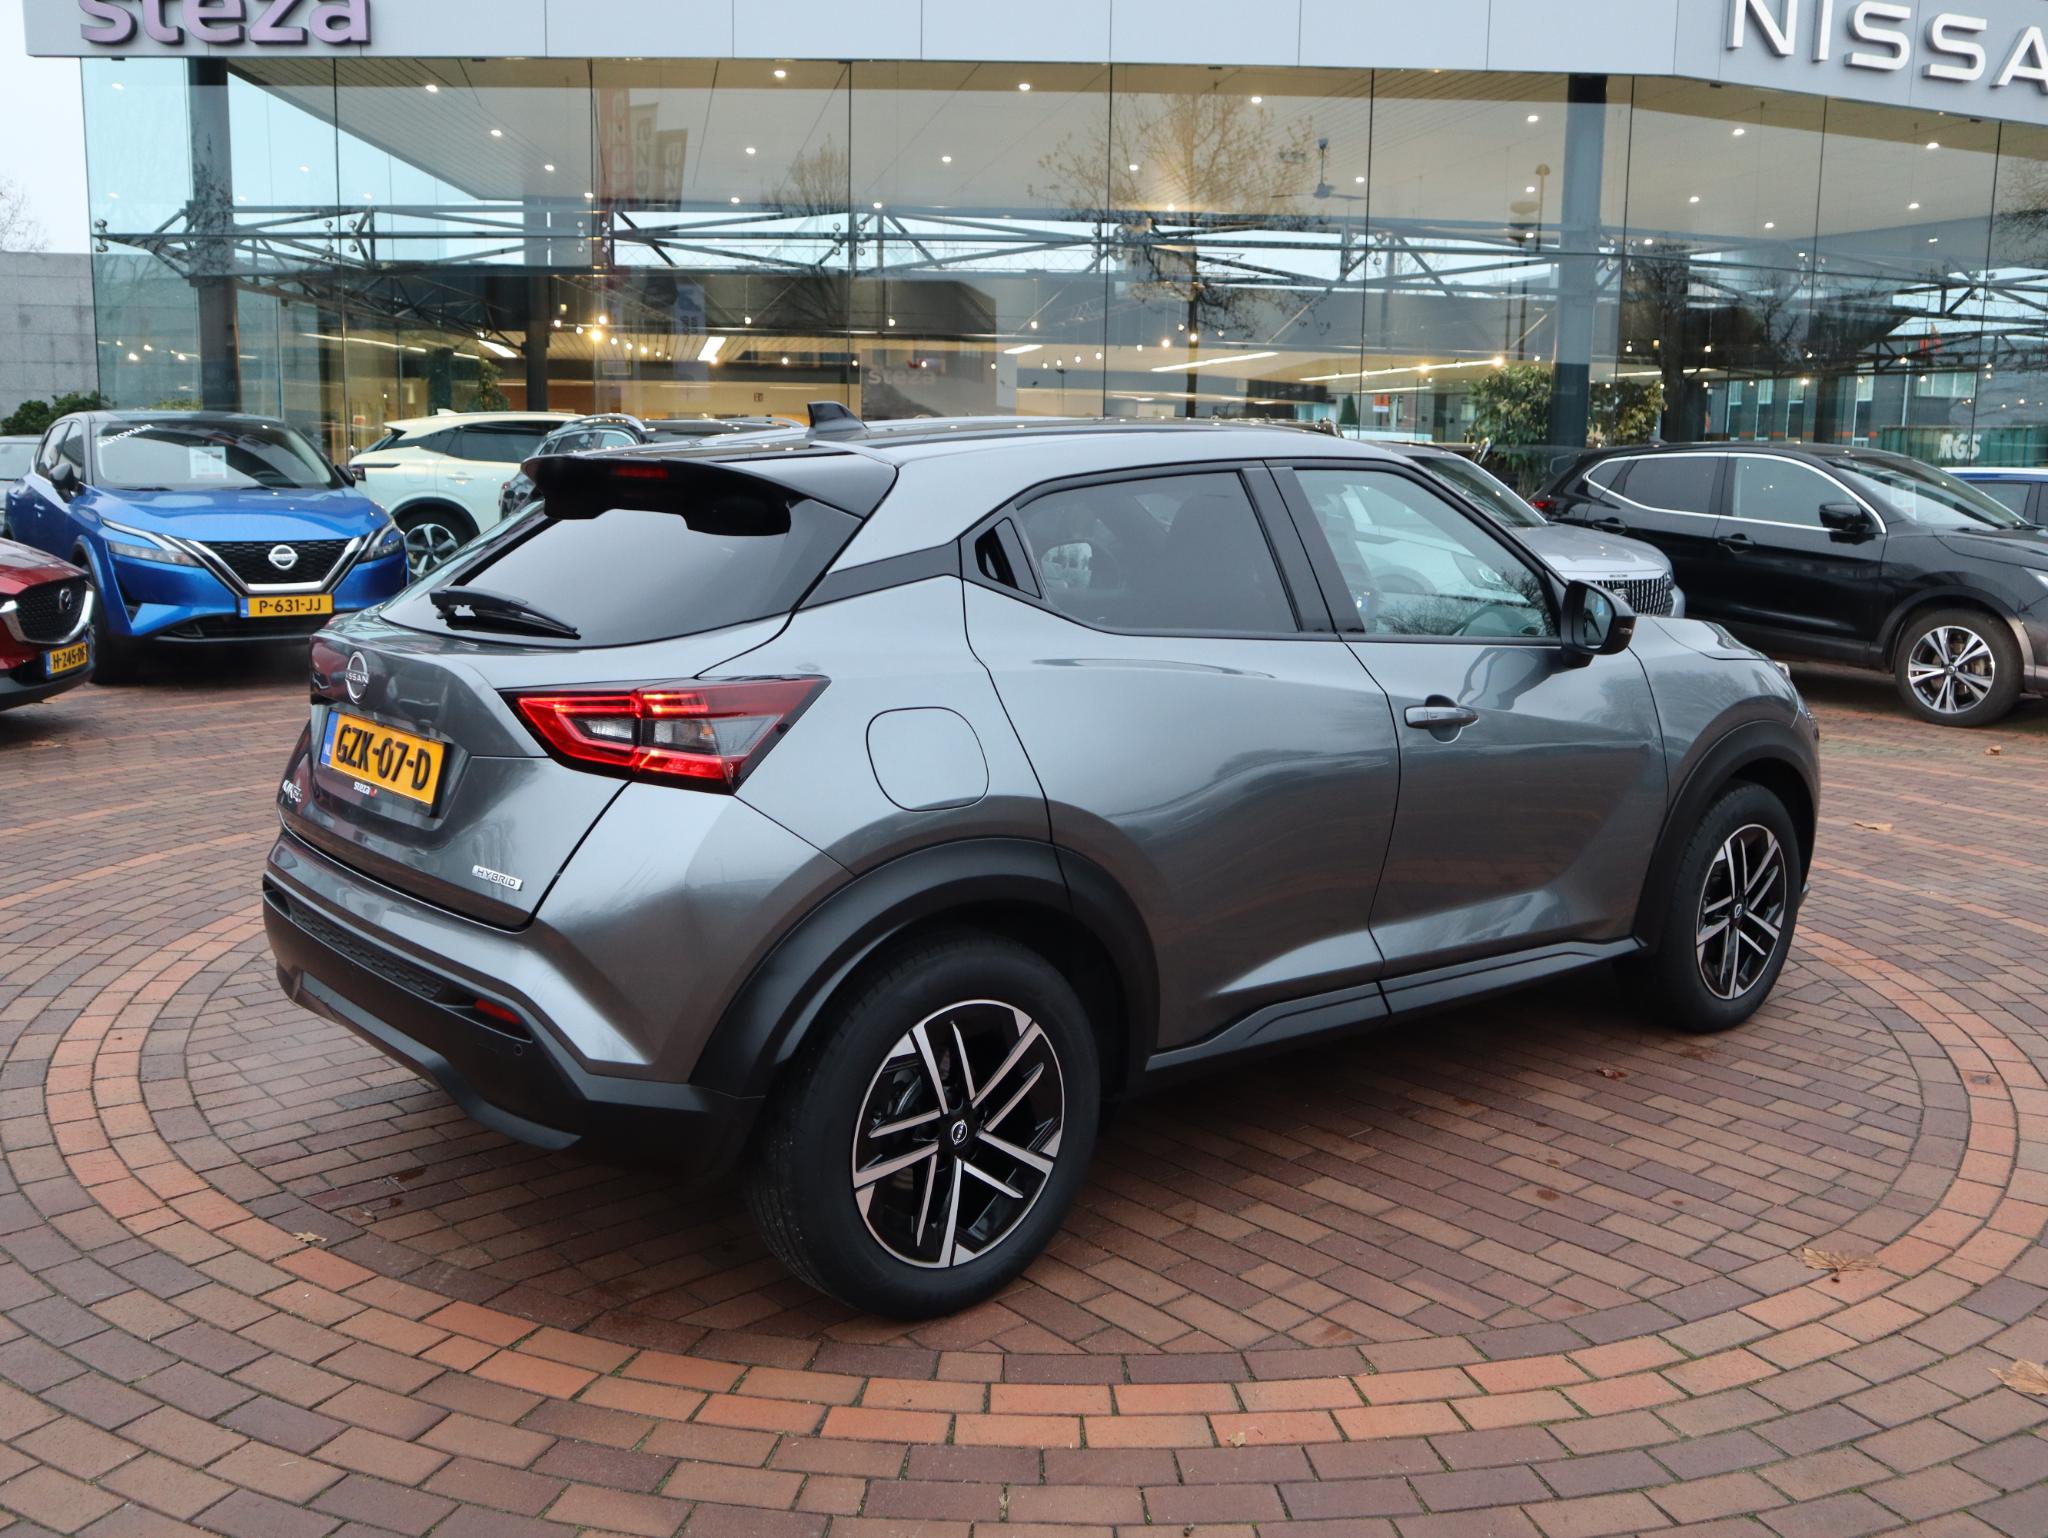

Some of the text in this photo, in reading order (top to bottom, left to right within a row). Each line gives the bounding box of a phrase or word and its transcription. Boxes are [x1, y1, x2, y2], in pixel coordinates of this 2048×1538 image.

[80, 0, 371, 46] steza
[1727, 0, 2048, 95] NISSA
[97, 424, 155, 448] AUTOMAAT
[1938, 433, 1982, 460] RGS
[259, 598, 321, 614] P-631-JJ
[336, 724, 432, 791] GZK-07-D
[476, 867, 517, 887] HYBRID
